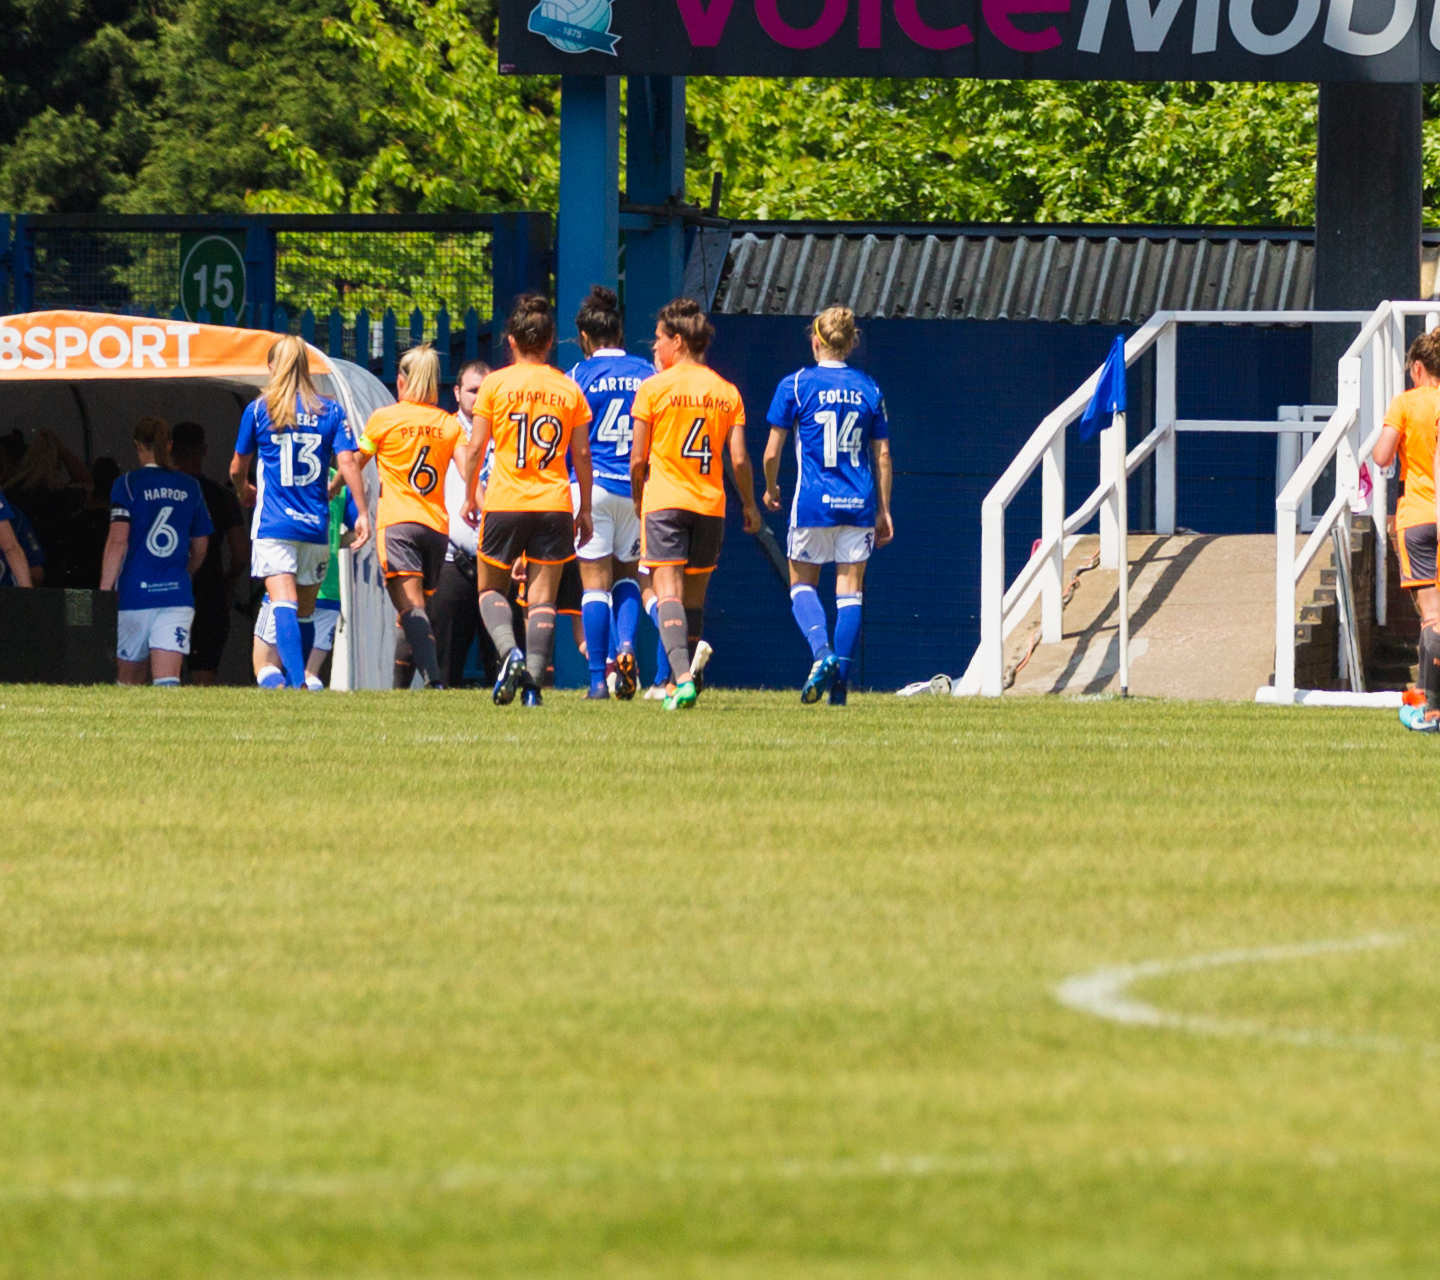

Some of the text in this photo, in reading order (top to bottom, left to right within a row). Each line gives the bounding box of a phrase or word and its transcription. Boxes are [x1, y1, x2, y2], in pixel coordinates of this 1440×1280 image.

[192, 264, 234, 308] 15
[507, 390, 567, 408] CHAPLEN
[669, 394, 731, 414] WILLIAMS
[818, 389, 863, 405] FOLLIS
[400, 426, 444, 440] PEARCE
[509, 411, 563, 470] 19
[597, 398, 633, 457] 4
[681, 417, 713, 475] 4
[813, 410, 863, 468] 14
[270, 432, 322, 487] 13
[407, 445, 439, 497] 6
[144, 487, 188, 502] HARROP
[146, 506, 179, 558] 6
